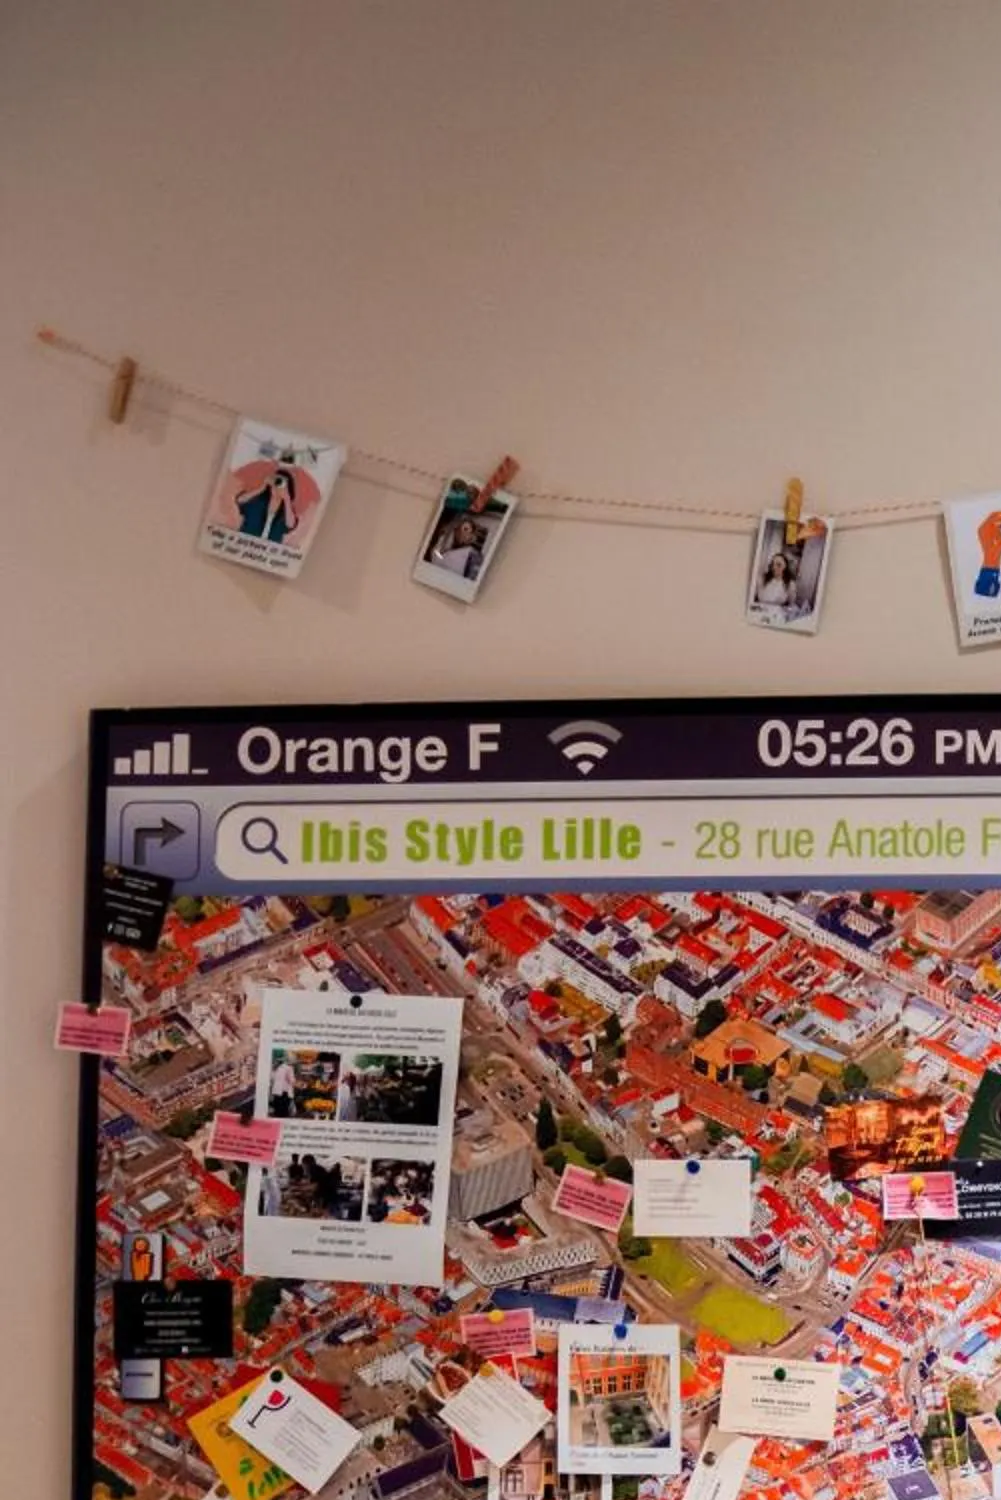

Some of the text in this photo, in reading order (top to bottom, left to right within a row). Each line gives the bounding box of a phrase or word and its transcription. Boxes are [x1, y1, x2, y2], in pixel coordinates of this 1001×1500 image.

[237, 723, 502, 783] Orange F
[757, 718, 915, 767] 05:26
[301, 819, 388, 864] Ibis
[404, 817, 525, 866] Style
[541, 816, 642, 862] Lille
[694, 820, 742, 861] 28
[756, 826, 815, 859] rue
[827, 817, 967, 859] Anatole
